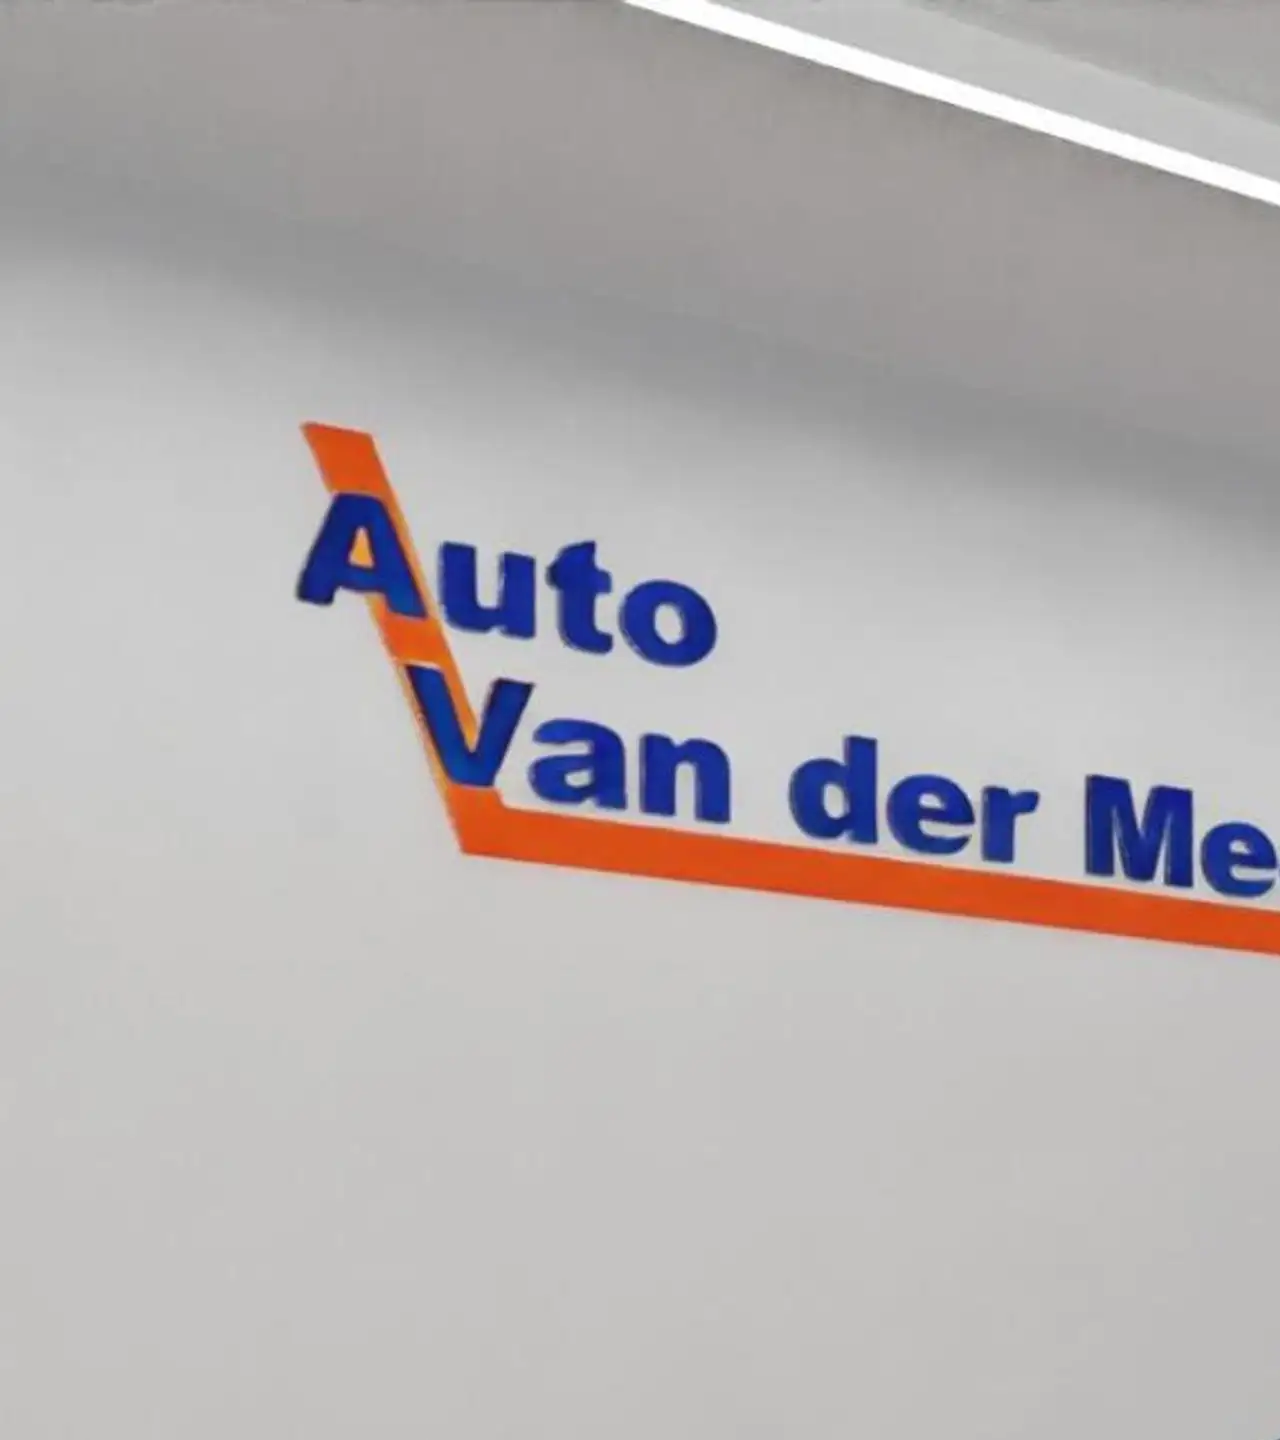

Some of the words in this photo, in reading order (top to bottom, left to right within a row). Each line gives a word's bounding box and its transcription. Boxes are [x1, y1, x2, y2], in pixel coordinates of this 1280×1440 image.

[297, 492, 718, 667] Auto
[405, 663, 731, 823] Van
[788, 735, 1039, 863] der
